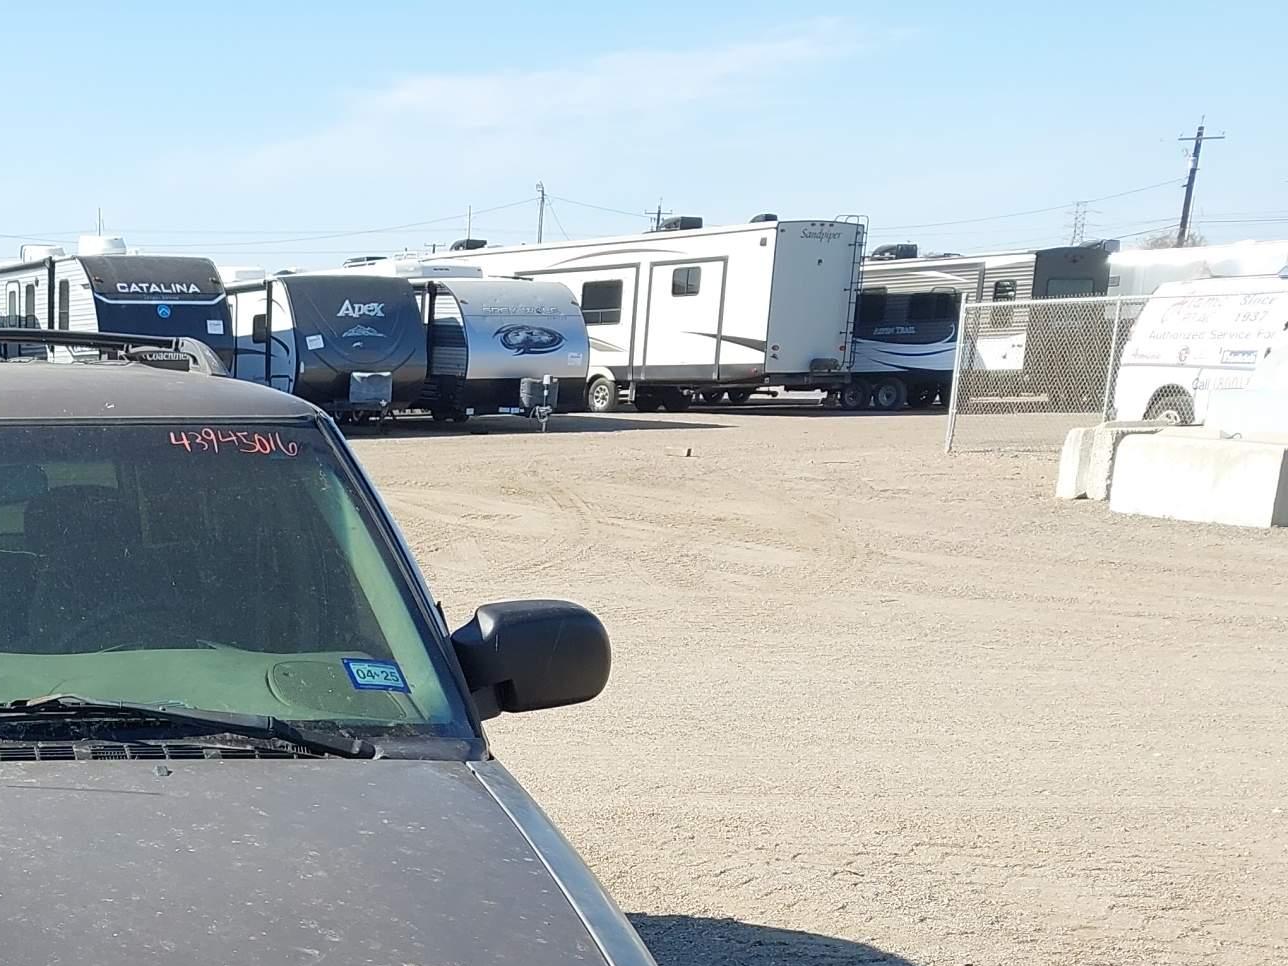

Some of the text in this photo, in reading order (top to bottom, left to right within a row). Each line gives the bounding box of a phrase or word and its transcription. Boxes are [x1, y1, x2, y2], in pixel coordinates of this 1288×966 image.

[116, 282, 201, 293] CATALINA
[336, 299, 384, 318] Apex
[169, 427, 299, 456] 43945016
